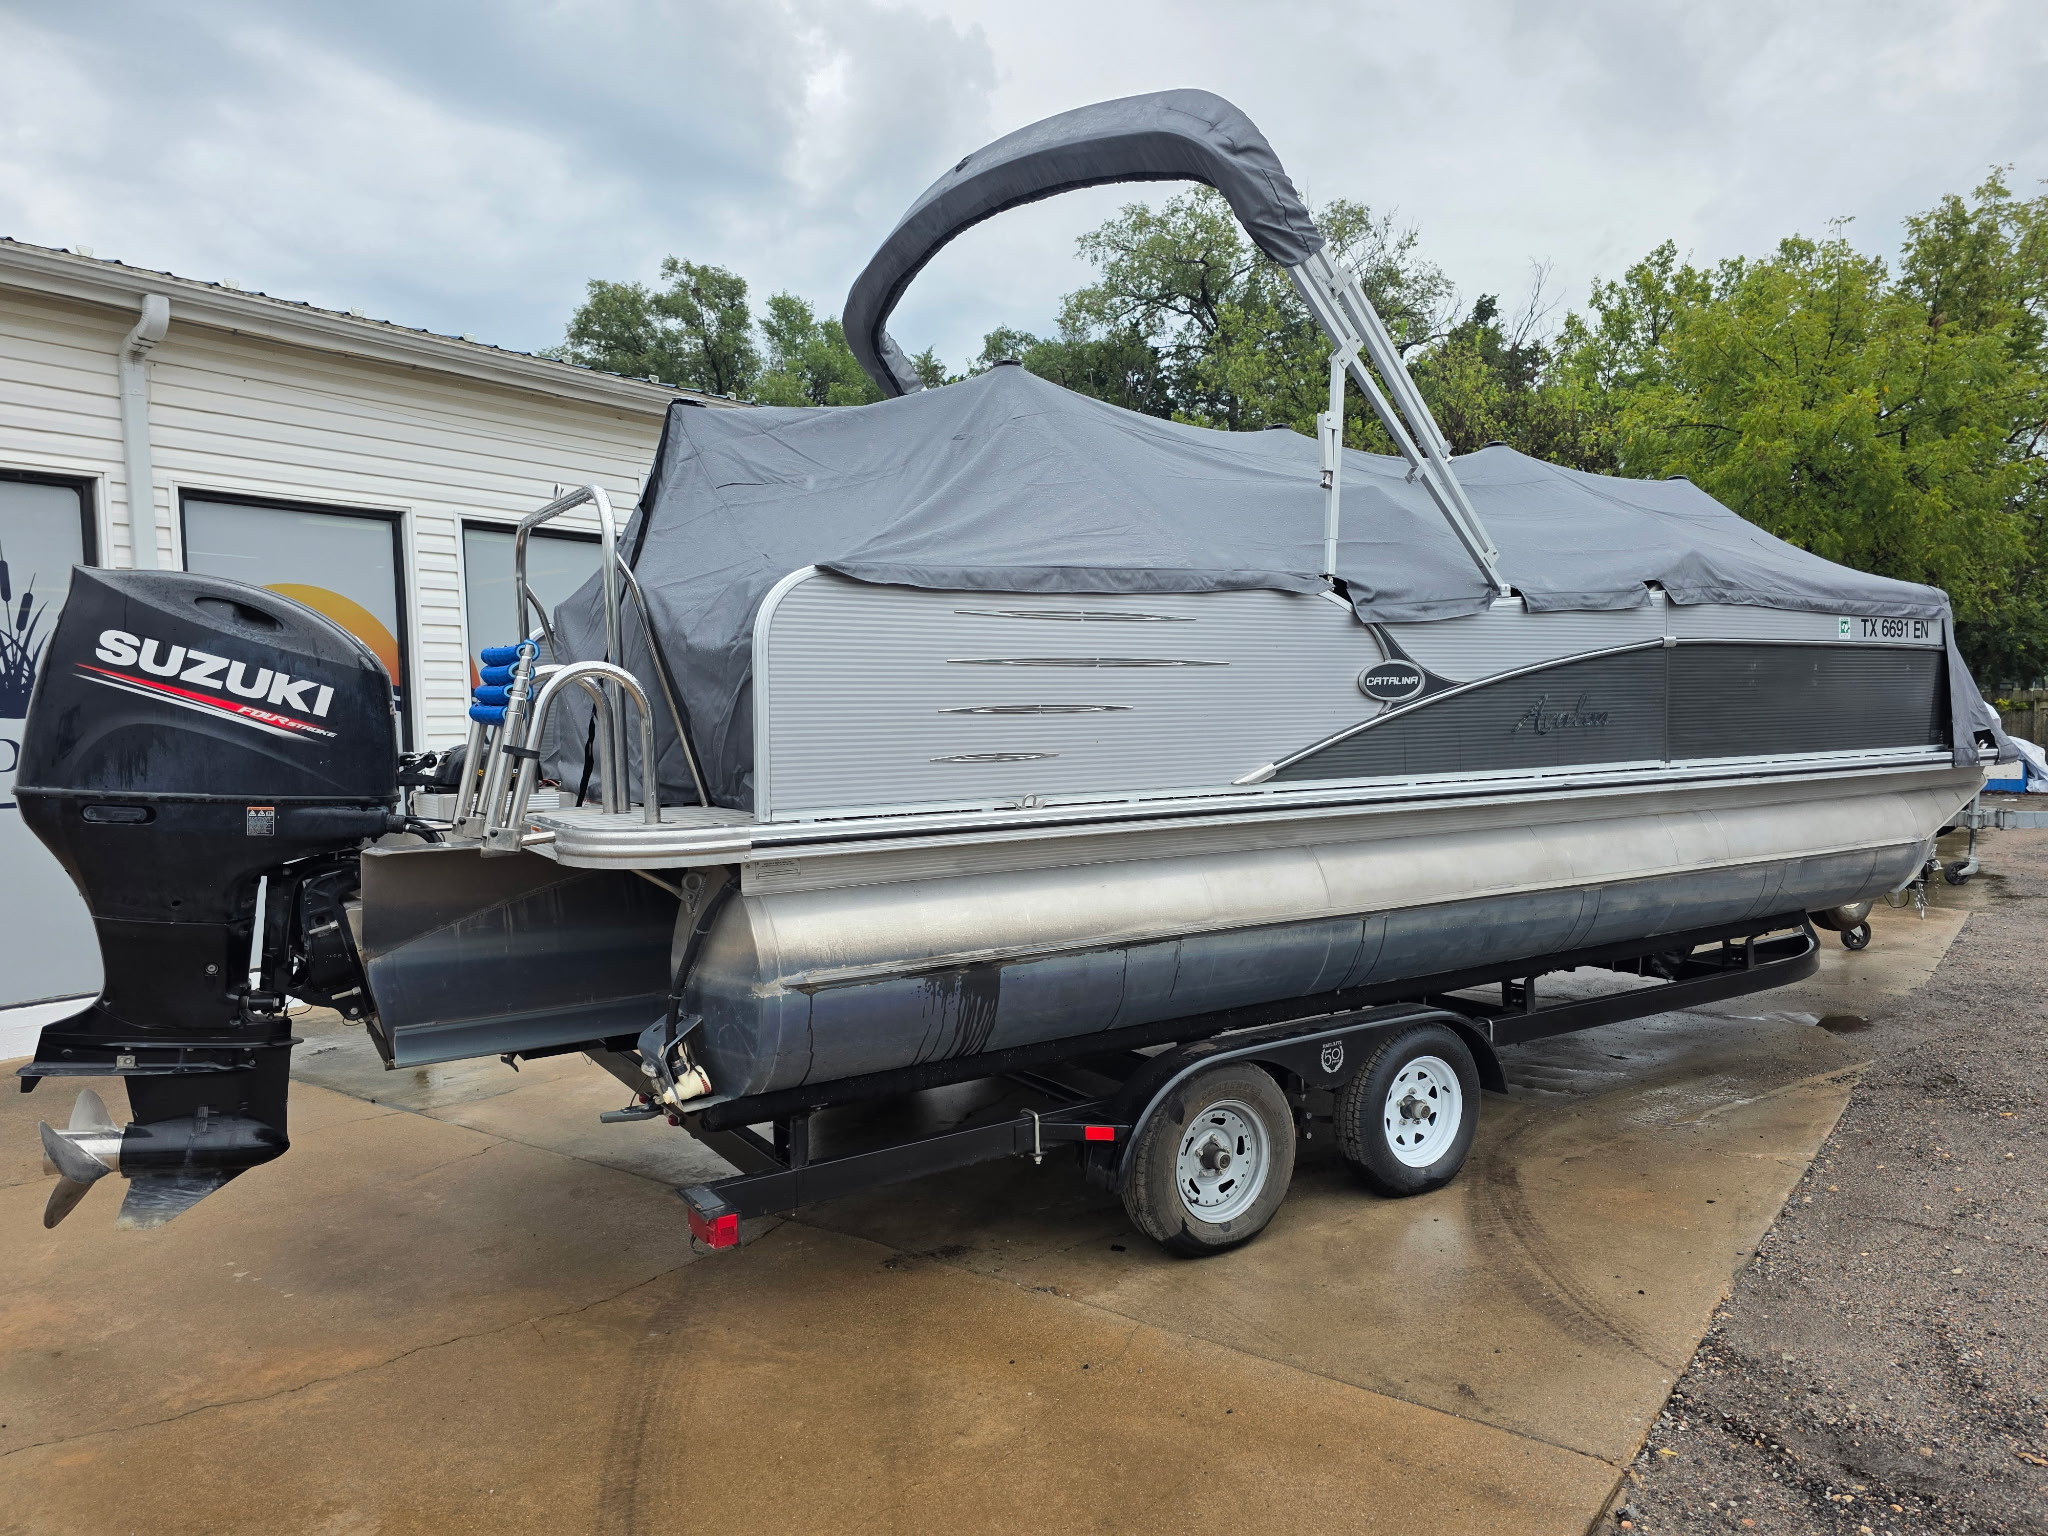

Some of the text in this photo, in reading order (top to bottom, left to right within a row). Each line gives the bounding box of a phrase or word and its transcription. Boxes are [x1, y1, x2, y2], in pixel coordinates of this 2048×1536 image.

[1861, 618, 1878, 638] TX
[1881, 618, 1909, 638] 6691
[1913, 620, 1929, 639] EN
[96, 629, 334, 717] SUZUKI
[1366, 675, 1419, 686] CATALINA
